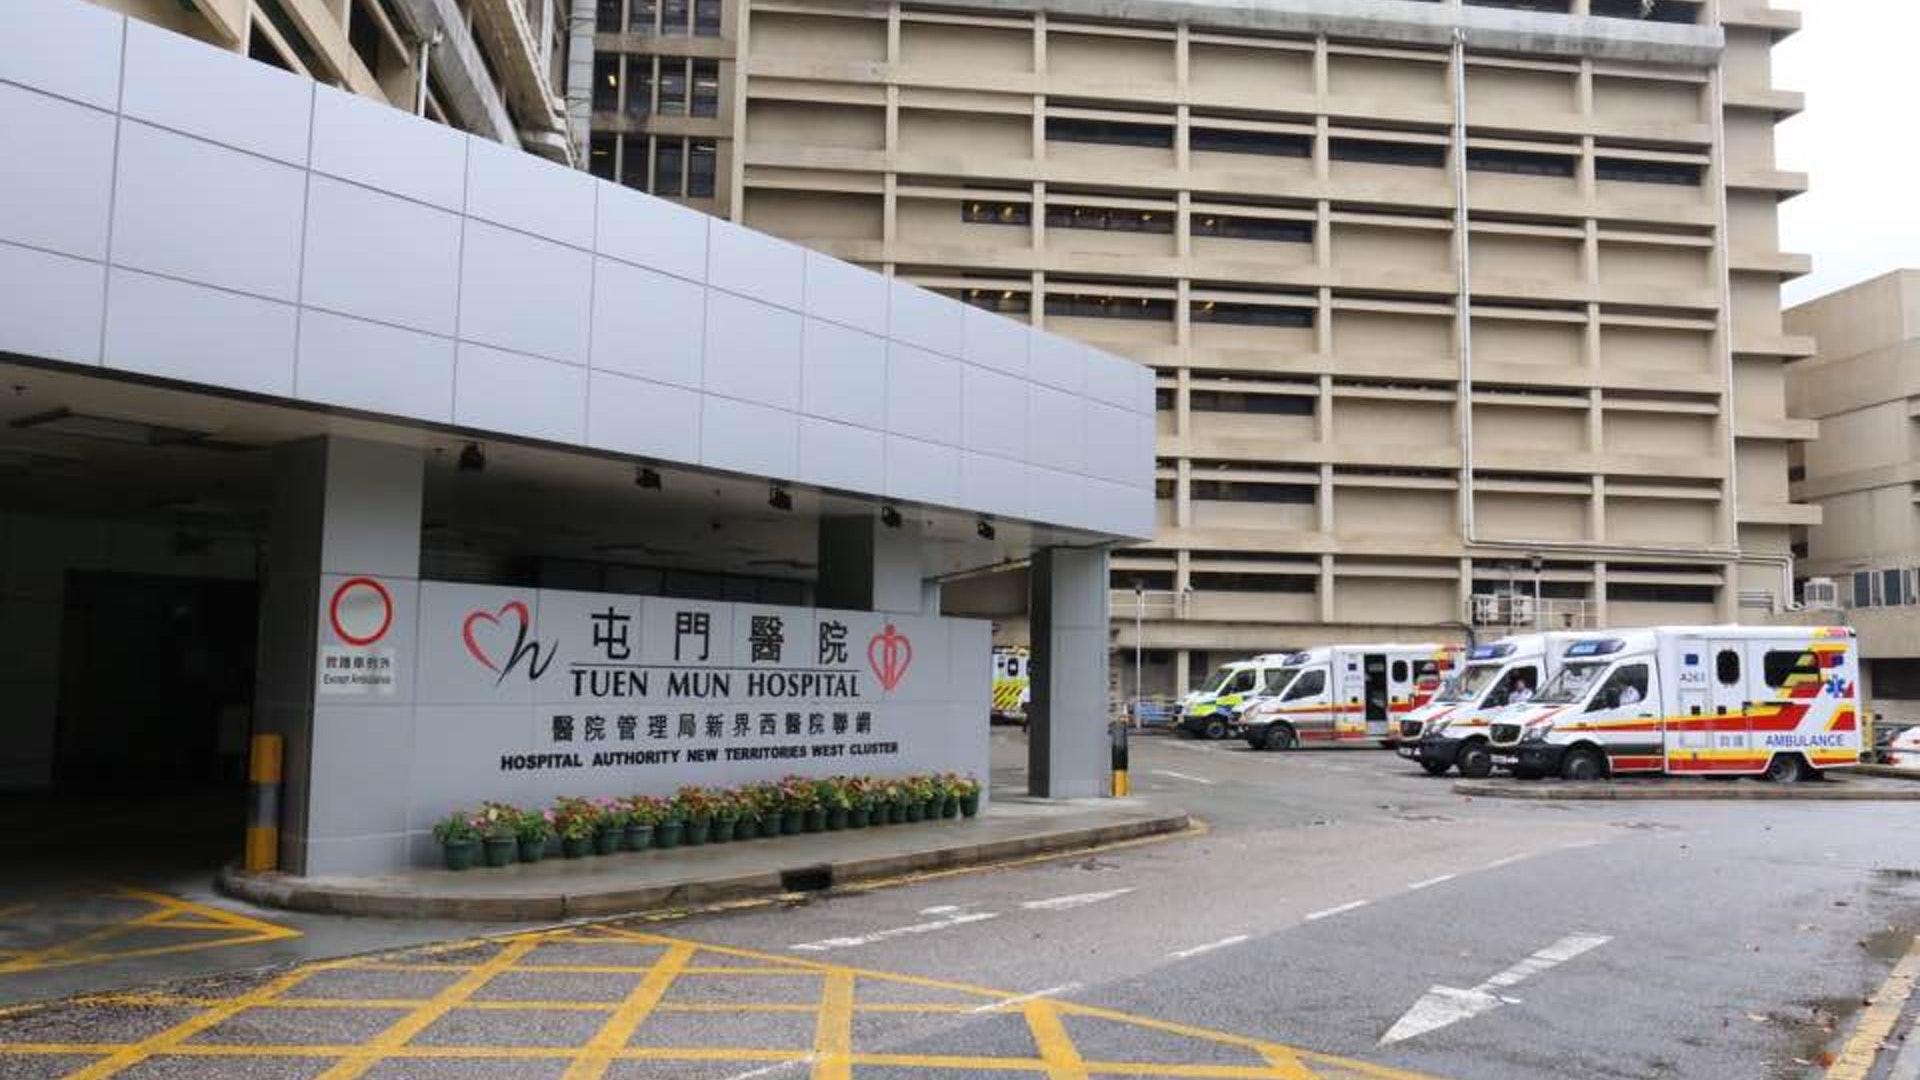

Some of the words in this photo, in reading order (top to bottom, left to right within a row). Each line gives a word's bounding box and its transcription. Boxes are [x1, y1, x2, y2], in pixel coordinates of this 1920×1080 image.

[591, 606, 848, 664] 屯門醫院
[570, 669, 649, 697] TUEN
[667, 671, 730, 698] MUN
[748, 672, 861, 697] HOSPITAL
[552, 711, 872, 742] 醫院管理局新界西醫院聯網
[1766, 734, 1845, 747] AMBULANCE
[501, 753, 583, 771] HOSPITAL
[592, 750, 682, 767] AUTHORITY
[687, 748, 718, 763] NEW
[724, 746, 807, 761] TERRITORIES
[812, 744, 844, 757] WEST
[849, 741, 898, 756] CLUSTER
